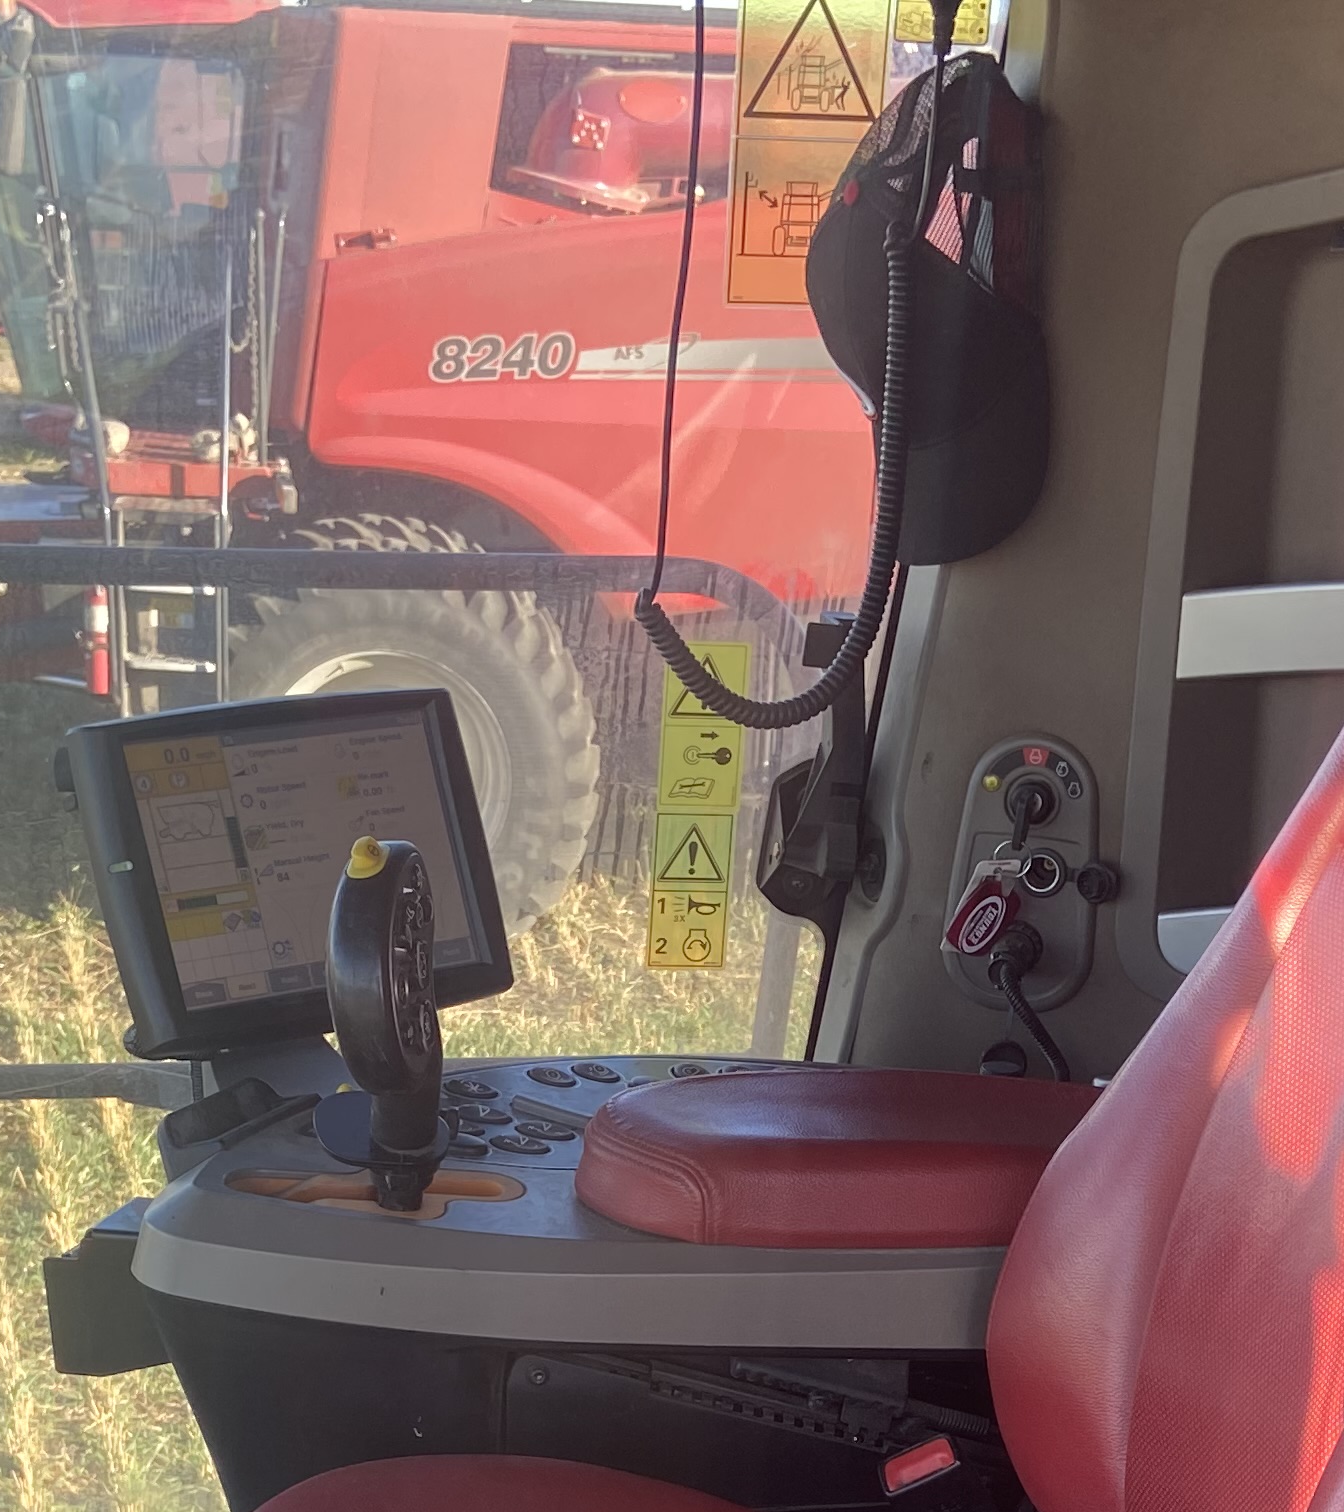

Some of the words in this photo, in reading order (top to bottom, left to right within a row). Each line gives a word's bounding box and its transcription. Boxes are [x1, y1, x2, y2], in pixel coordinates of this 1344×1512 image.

[429, 332, 575, 382] 8240
[613, 345, 645, 361] AFS
[163, 747, 190, 764] 0.0
[362, 786, 383, 798] 0.00
[277, 871, 290, 882] 84
[657, 897, 666, 914] 1
[655, 937, 668, 954] 2
